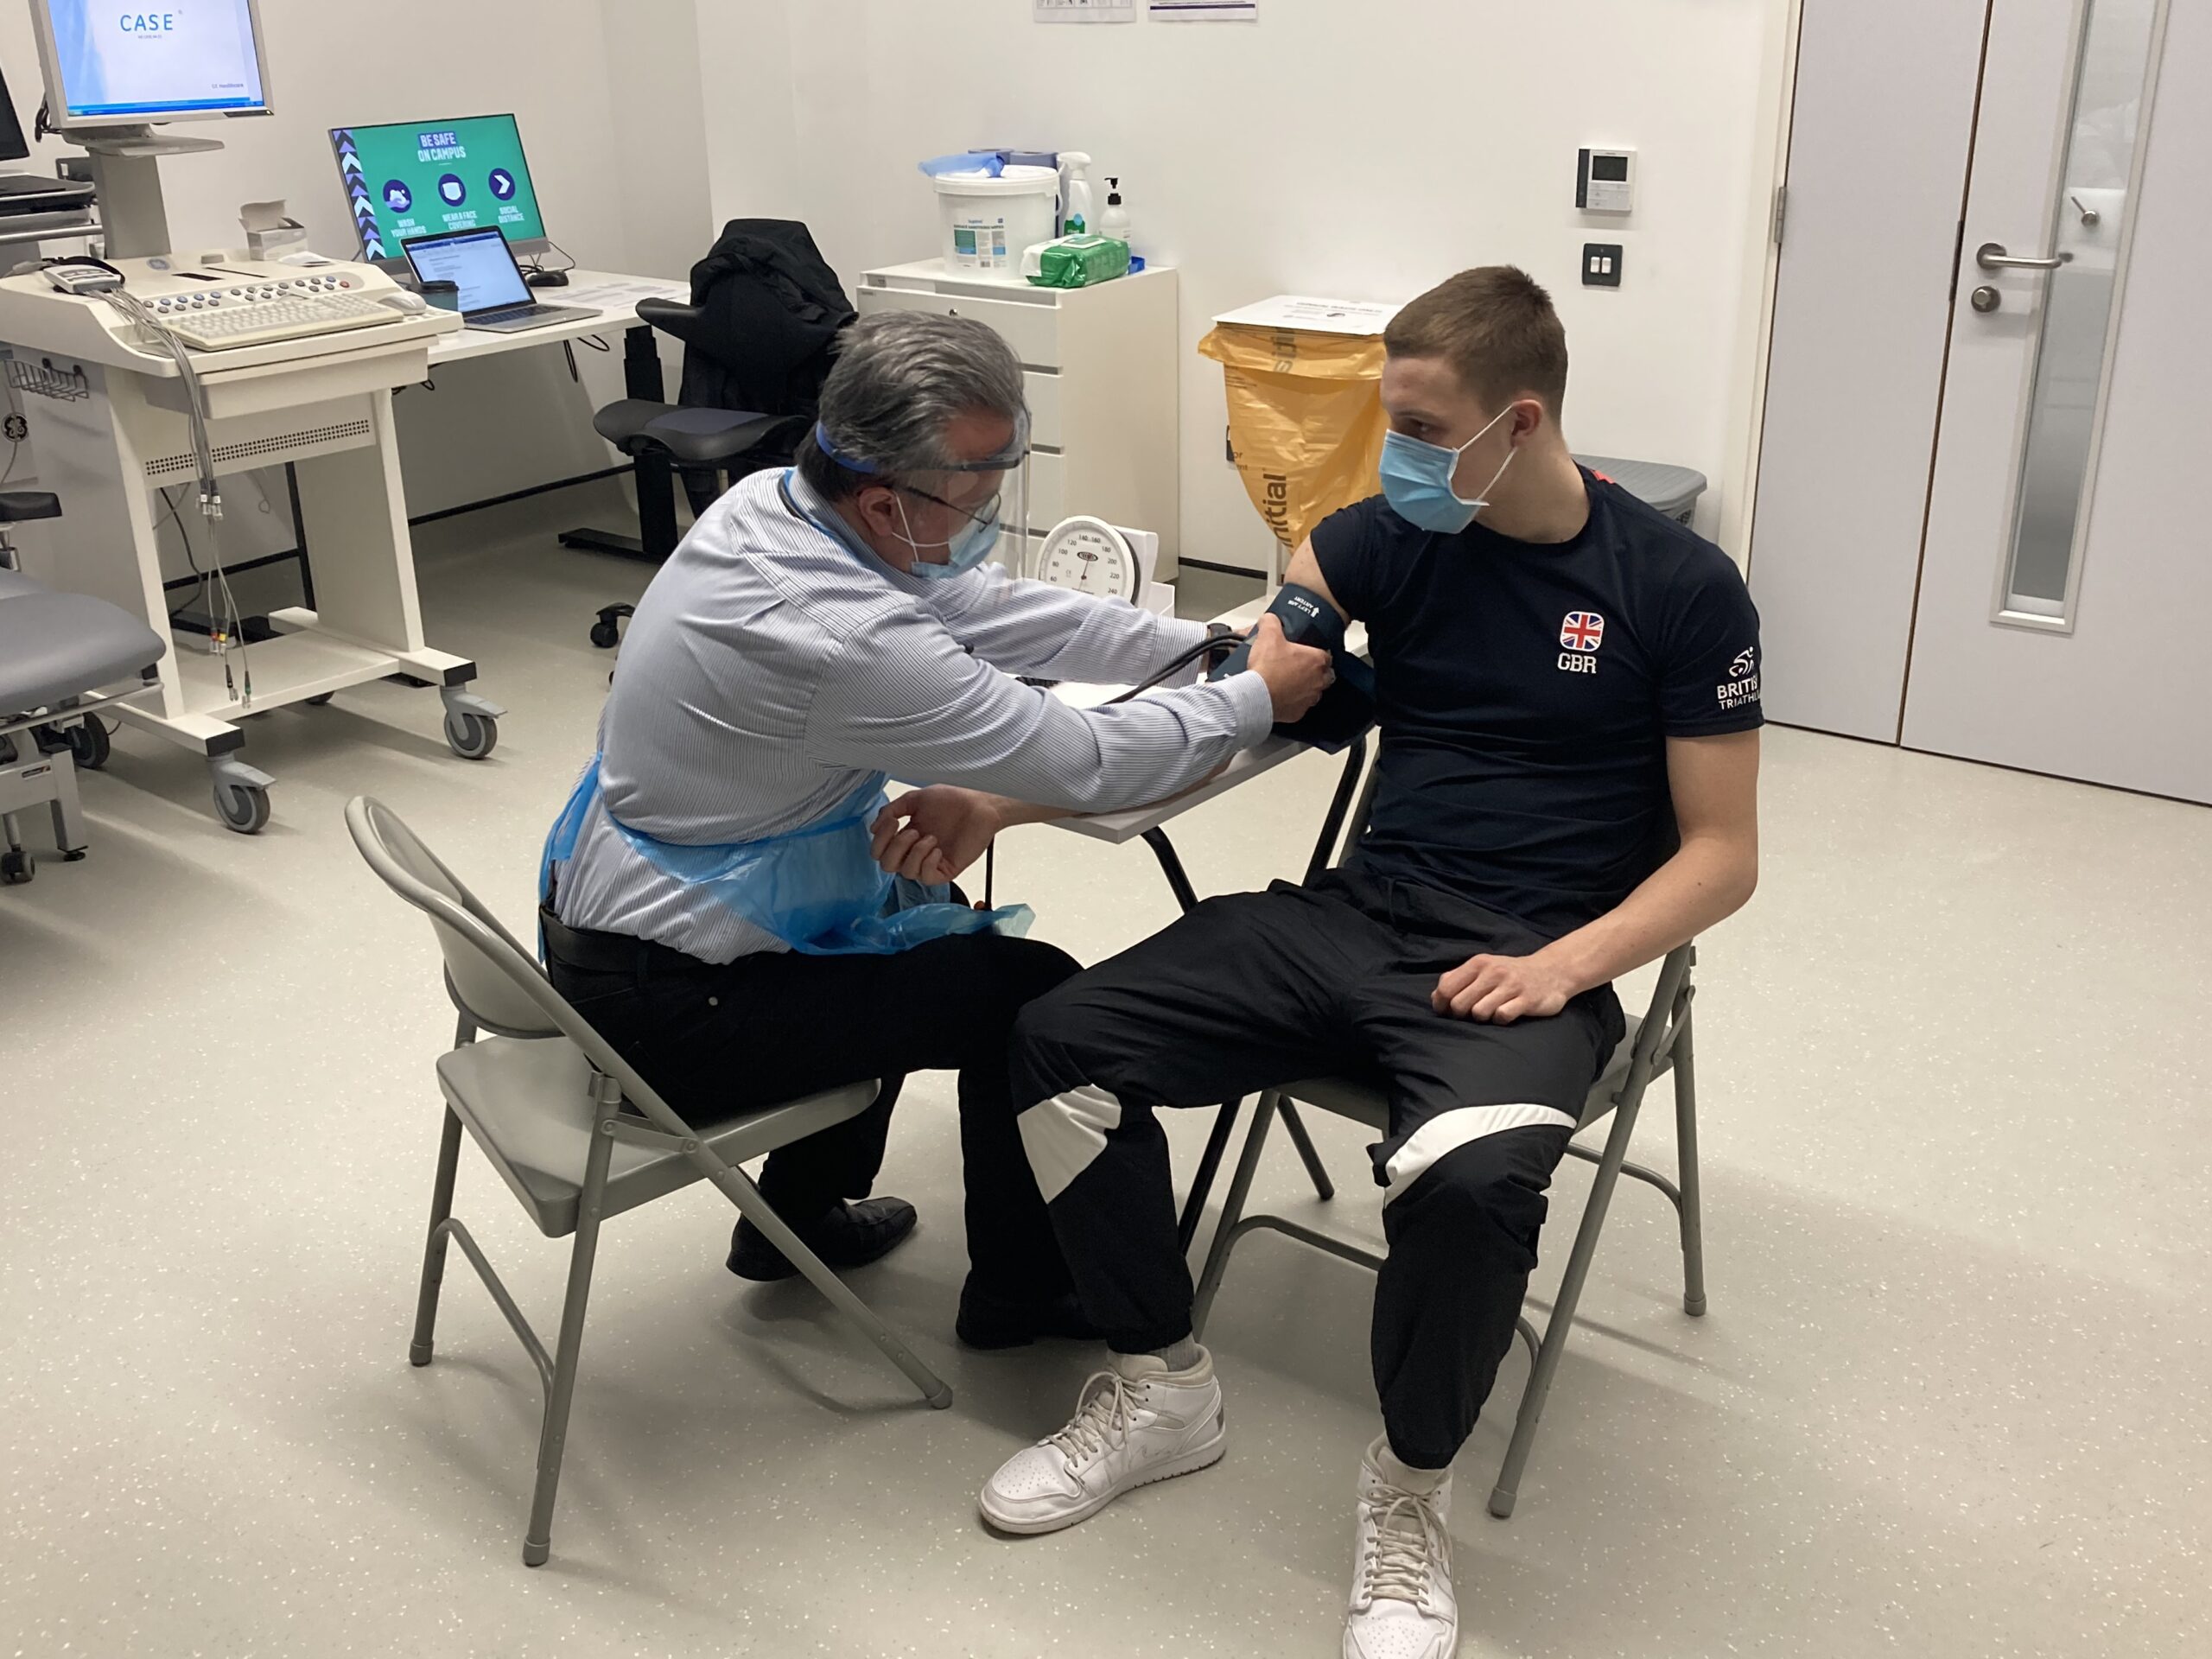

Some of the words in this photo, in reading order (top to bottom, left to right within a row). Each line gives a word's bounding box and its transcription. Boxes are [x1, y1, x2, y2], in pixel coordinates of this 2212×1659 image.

[119, 14, 174, 32] CASE
[420, 134, 434, 148] BE
[433, 132, 457, 146] SAFE
[417, 149, 432, 162] ON
[430, 145, 467, 161] CAMPUS
[397, 218, 416, 228] WASH
[442, 213, 459, 223] WEAR
[463, 210, 478, 220] FACE
[498, 213, 525, 224] DISTANCE
[391, 227, 408, 238] YOUR
[406, 225, 428, 237] HANDS
[448, 219, 477, 231] COVERING
[1298, 604, 1312, 614] LEFT
[1557, 652, 1598, 674] GBR
